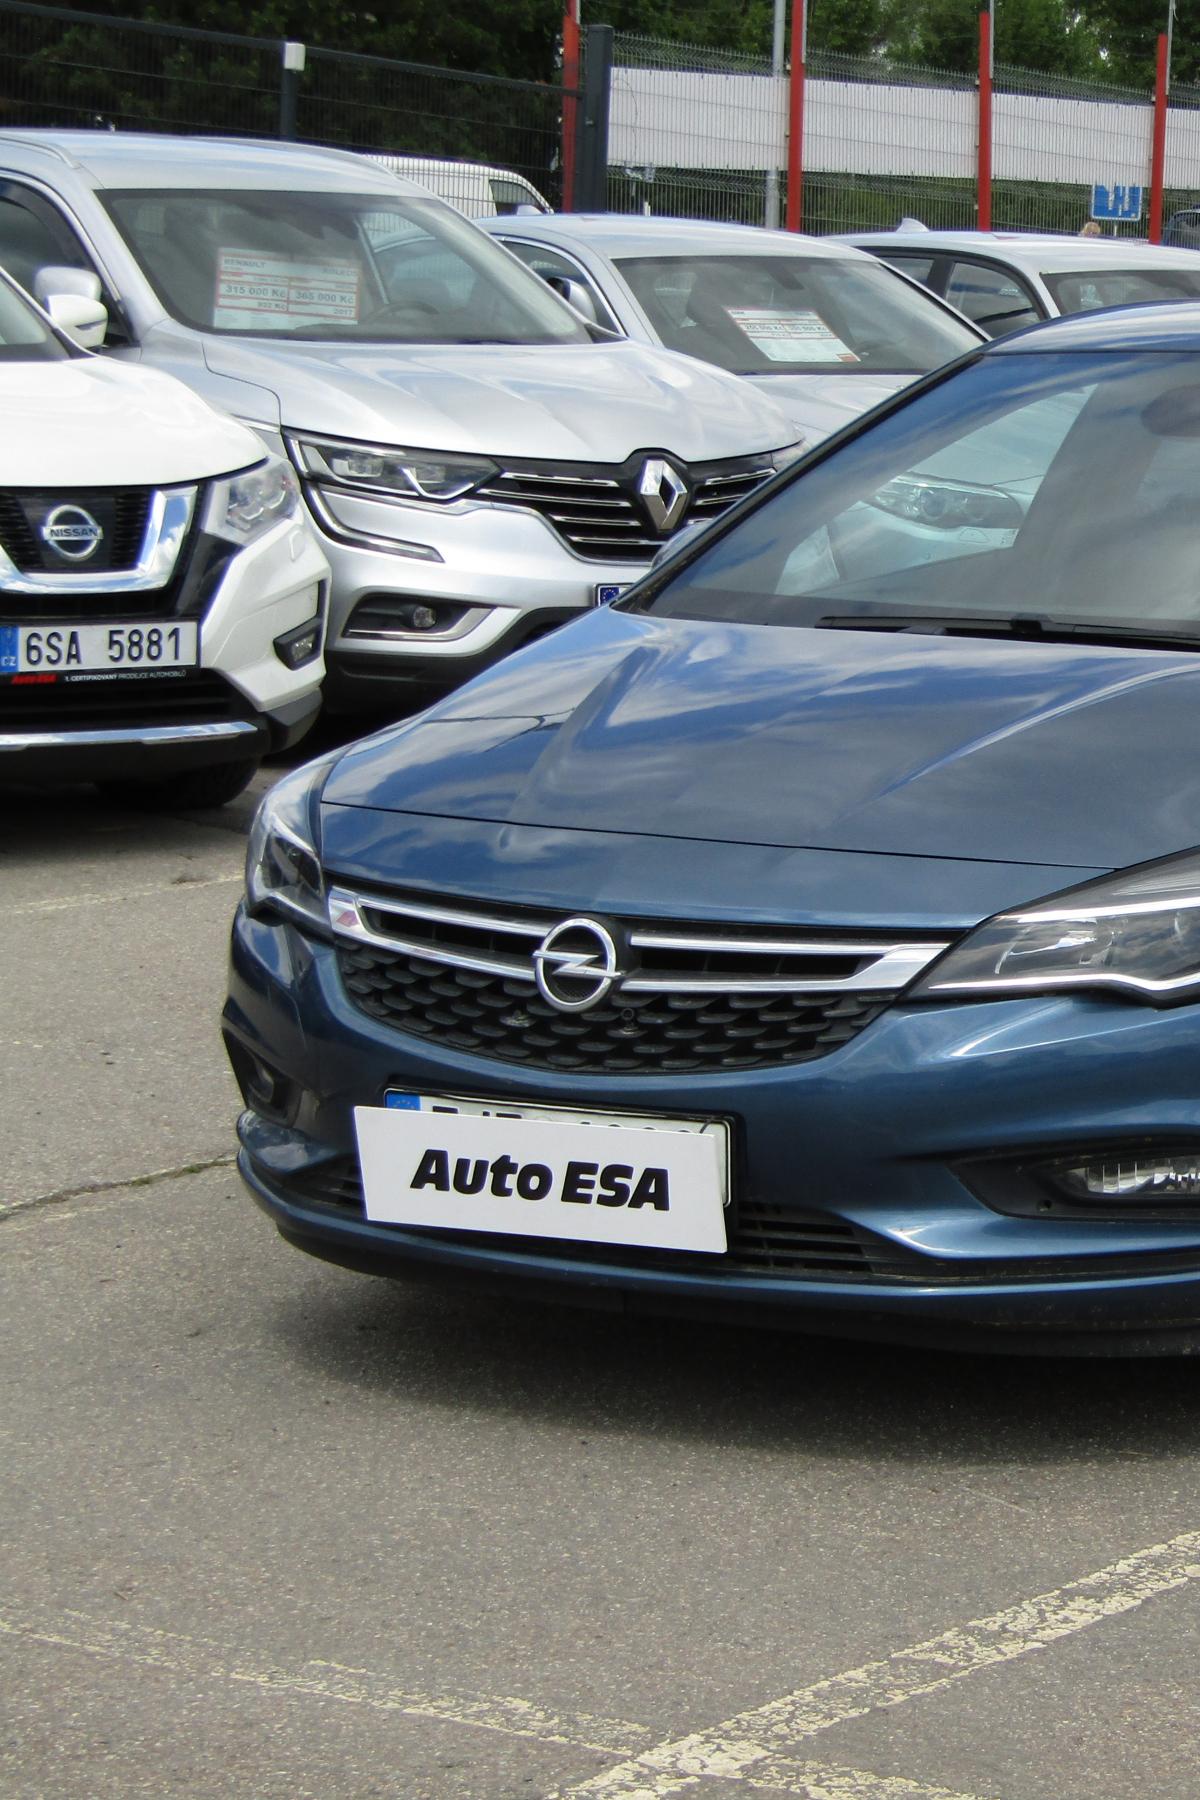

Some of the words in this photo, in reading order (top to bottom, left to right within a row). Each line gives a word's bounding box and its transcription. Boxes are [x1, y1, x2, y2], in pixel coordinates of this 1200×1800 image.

[49, 527, 98, 538] NISSAN
[25, 630, 82, 666] 6SA
[107, 627, 181, 663] 5881
[1, 655, 17, 667] CZ
[409, 1148, 553, 1202] Auto
[560, 1161, 670, 1212] ESA
